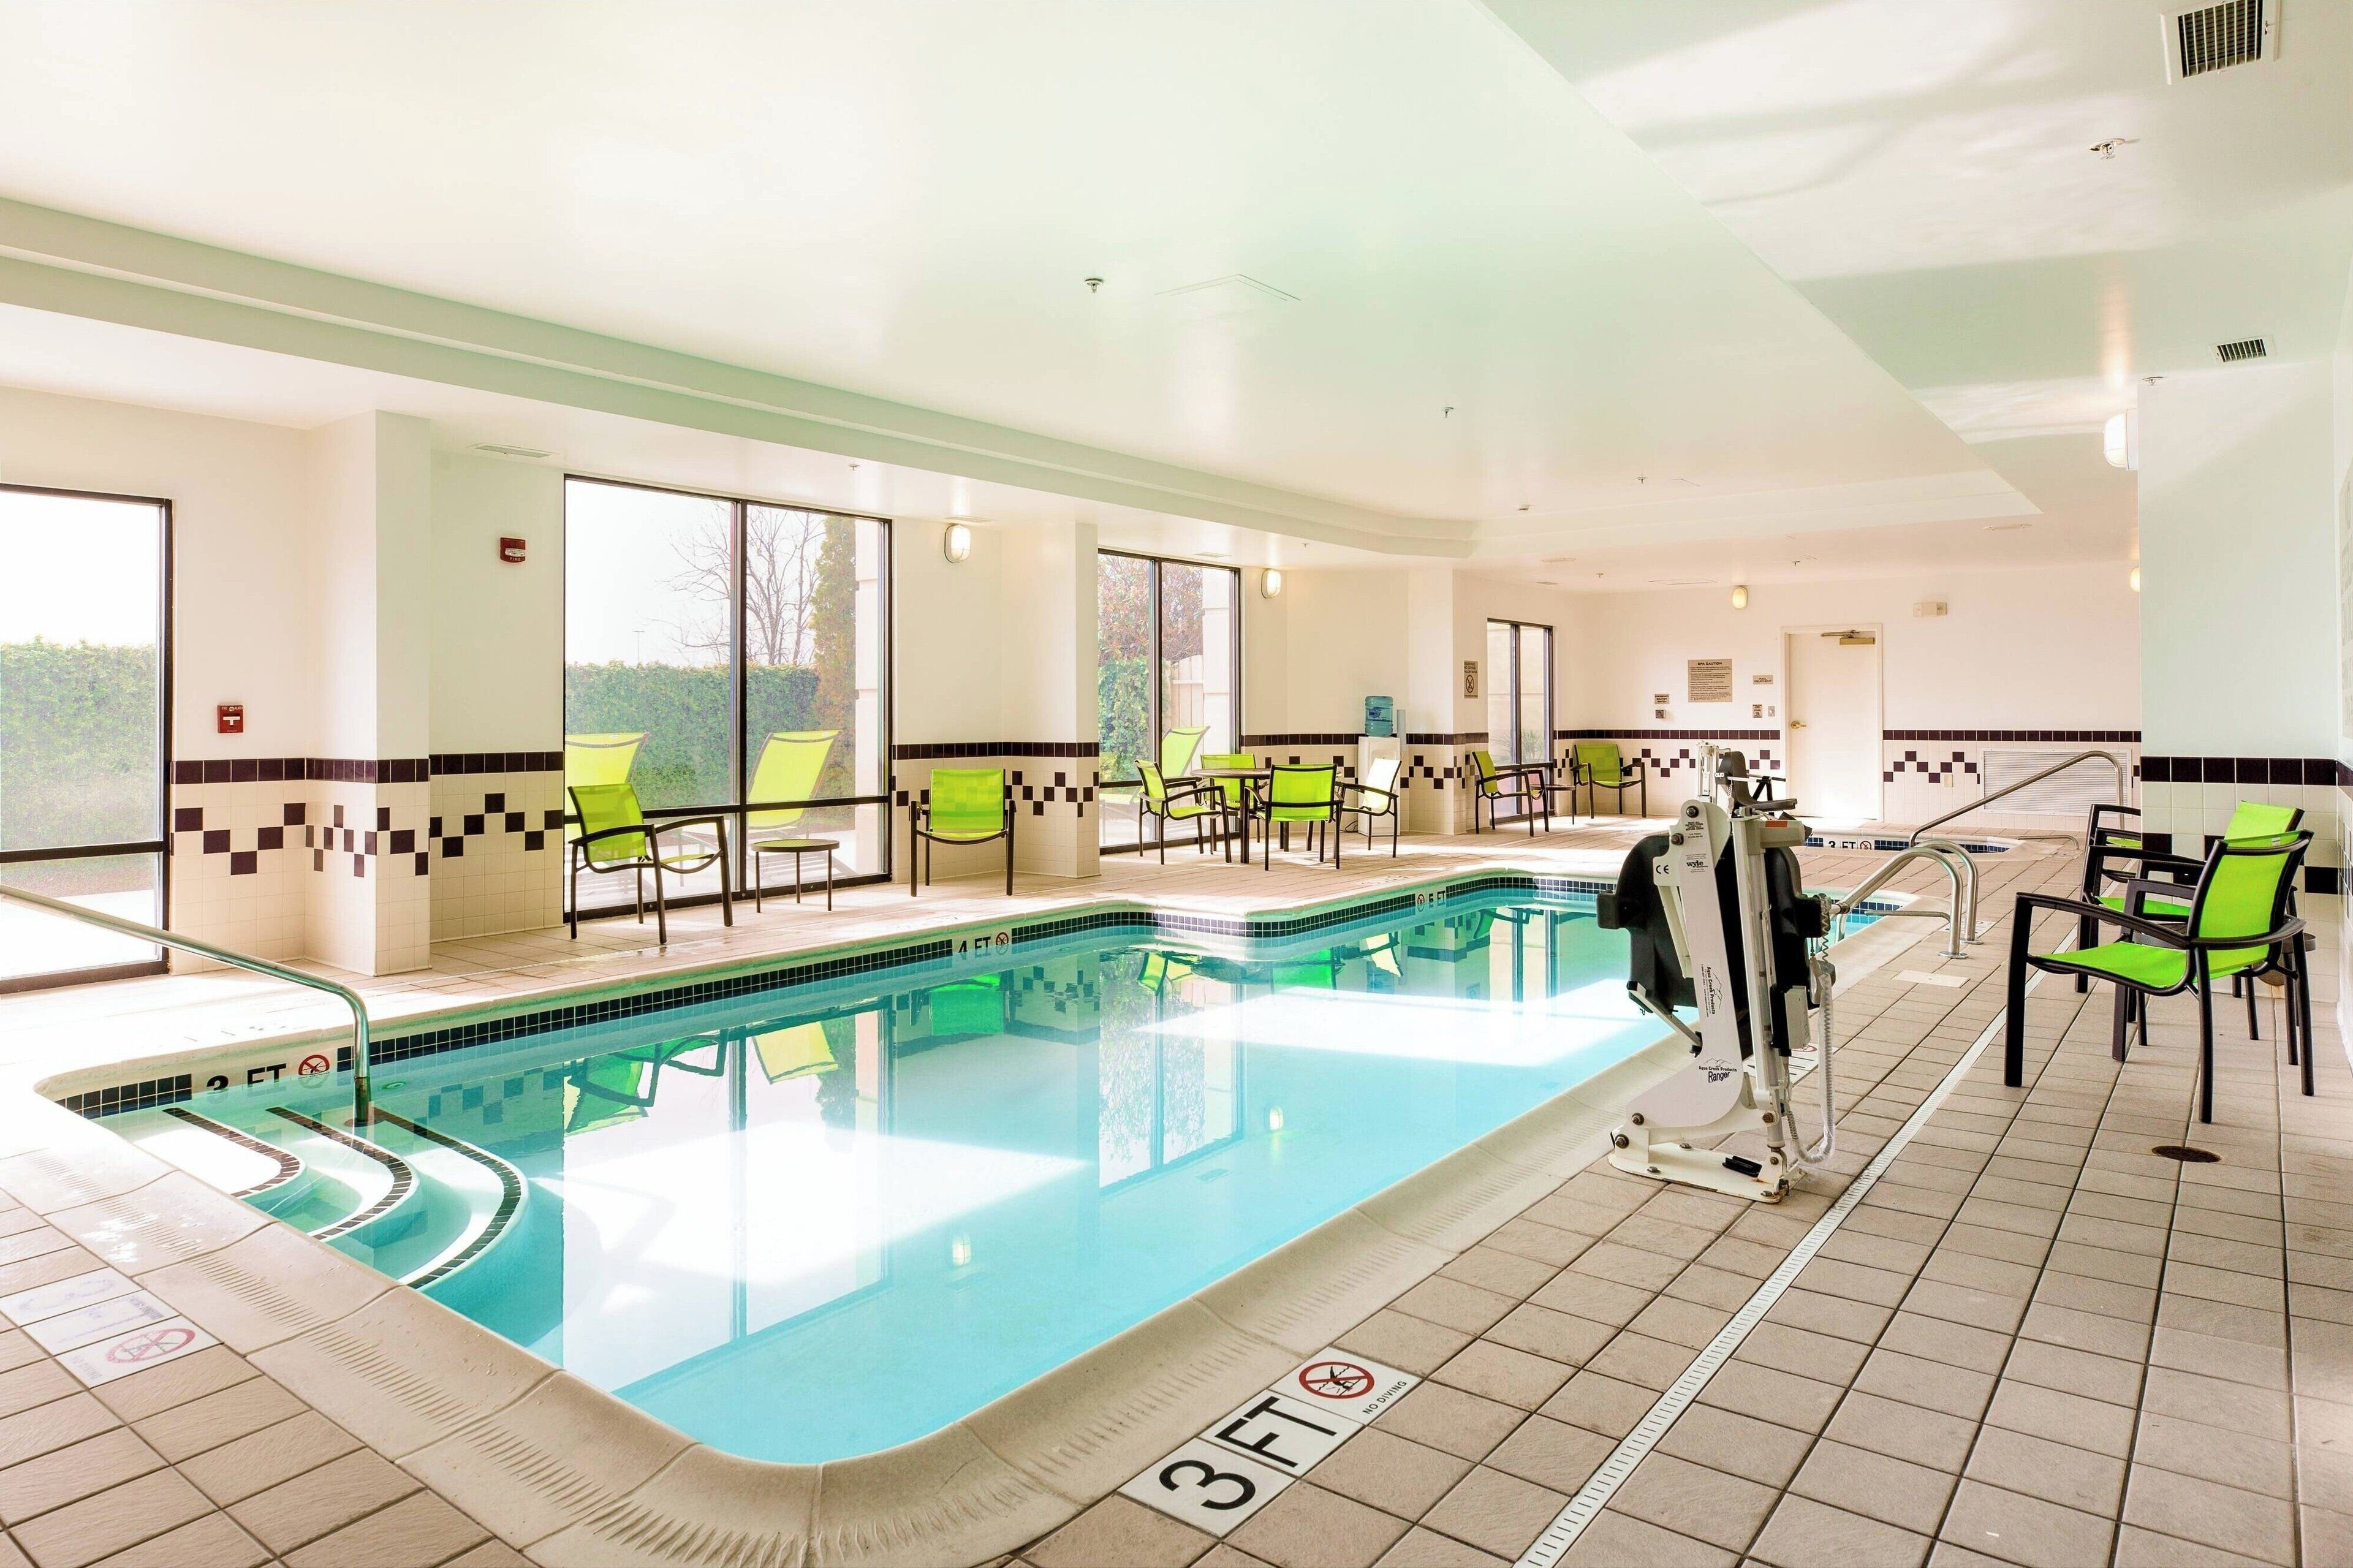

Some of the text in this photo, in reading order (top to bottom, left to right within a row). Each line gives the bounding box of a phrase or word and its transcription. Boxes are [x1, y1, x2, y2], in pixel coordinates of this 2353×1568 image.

[1656, 865, 1669, 874] CE
[1437, 890, 1446, 902] FT
[958, 936, 991, 953] 4 FT
[247, 1063, 287, 1088] FT
[1708, 1071, 1730, 1083] Ranger
[1362, 1381, 1407, 1414] NO DIVING
[1159, 1395, 1337, 1510] 3 FT
